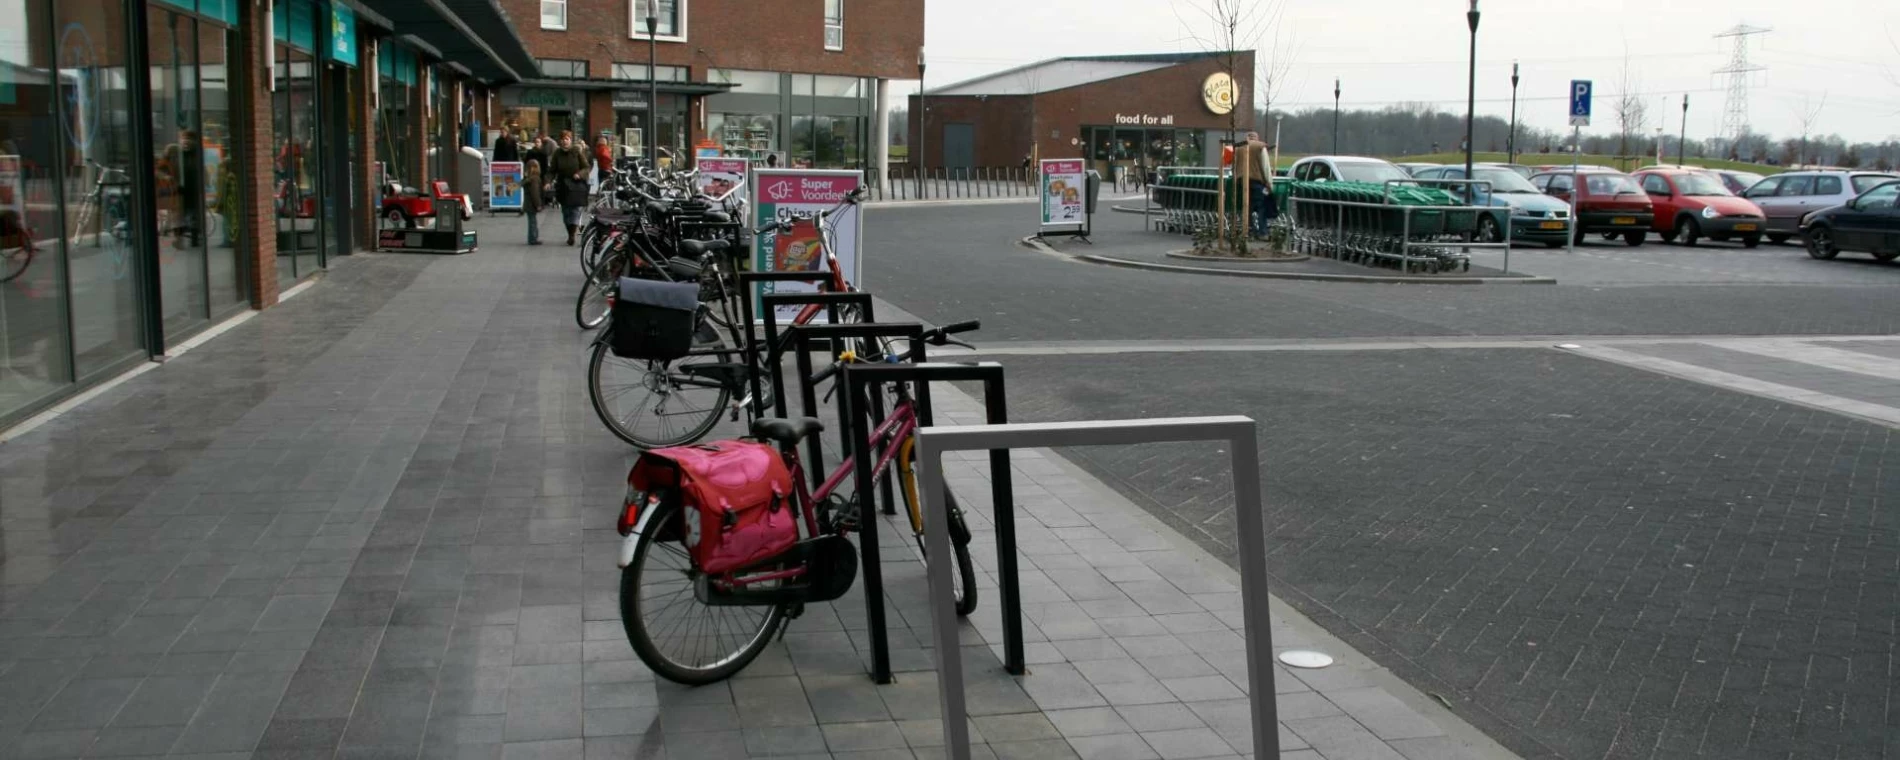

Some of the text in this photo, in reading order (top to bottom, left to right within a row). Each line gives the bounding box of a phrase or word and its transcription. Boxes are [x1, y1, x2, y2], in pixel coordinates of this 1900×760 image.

[1576, 84, 1587, 101] P
[1115, 114, 1173, 125] food for all
[801, 178, 833, 191] Super
[777, 207, 812, 218] Chips
